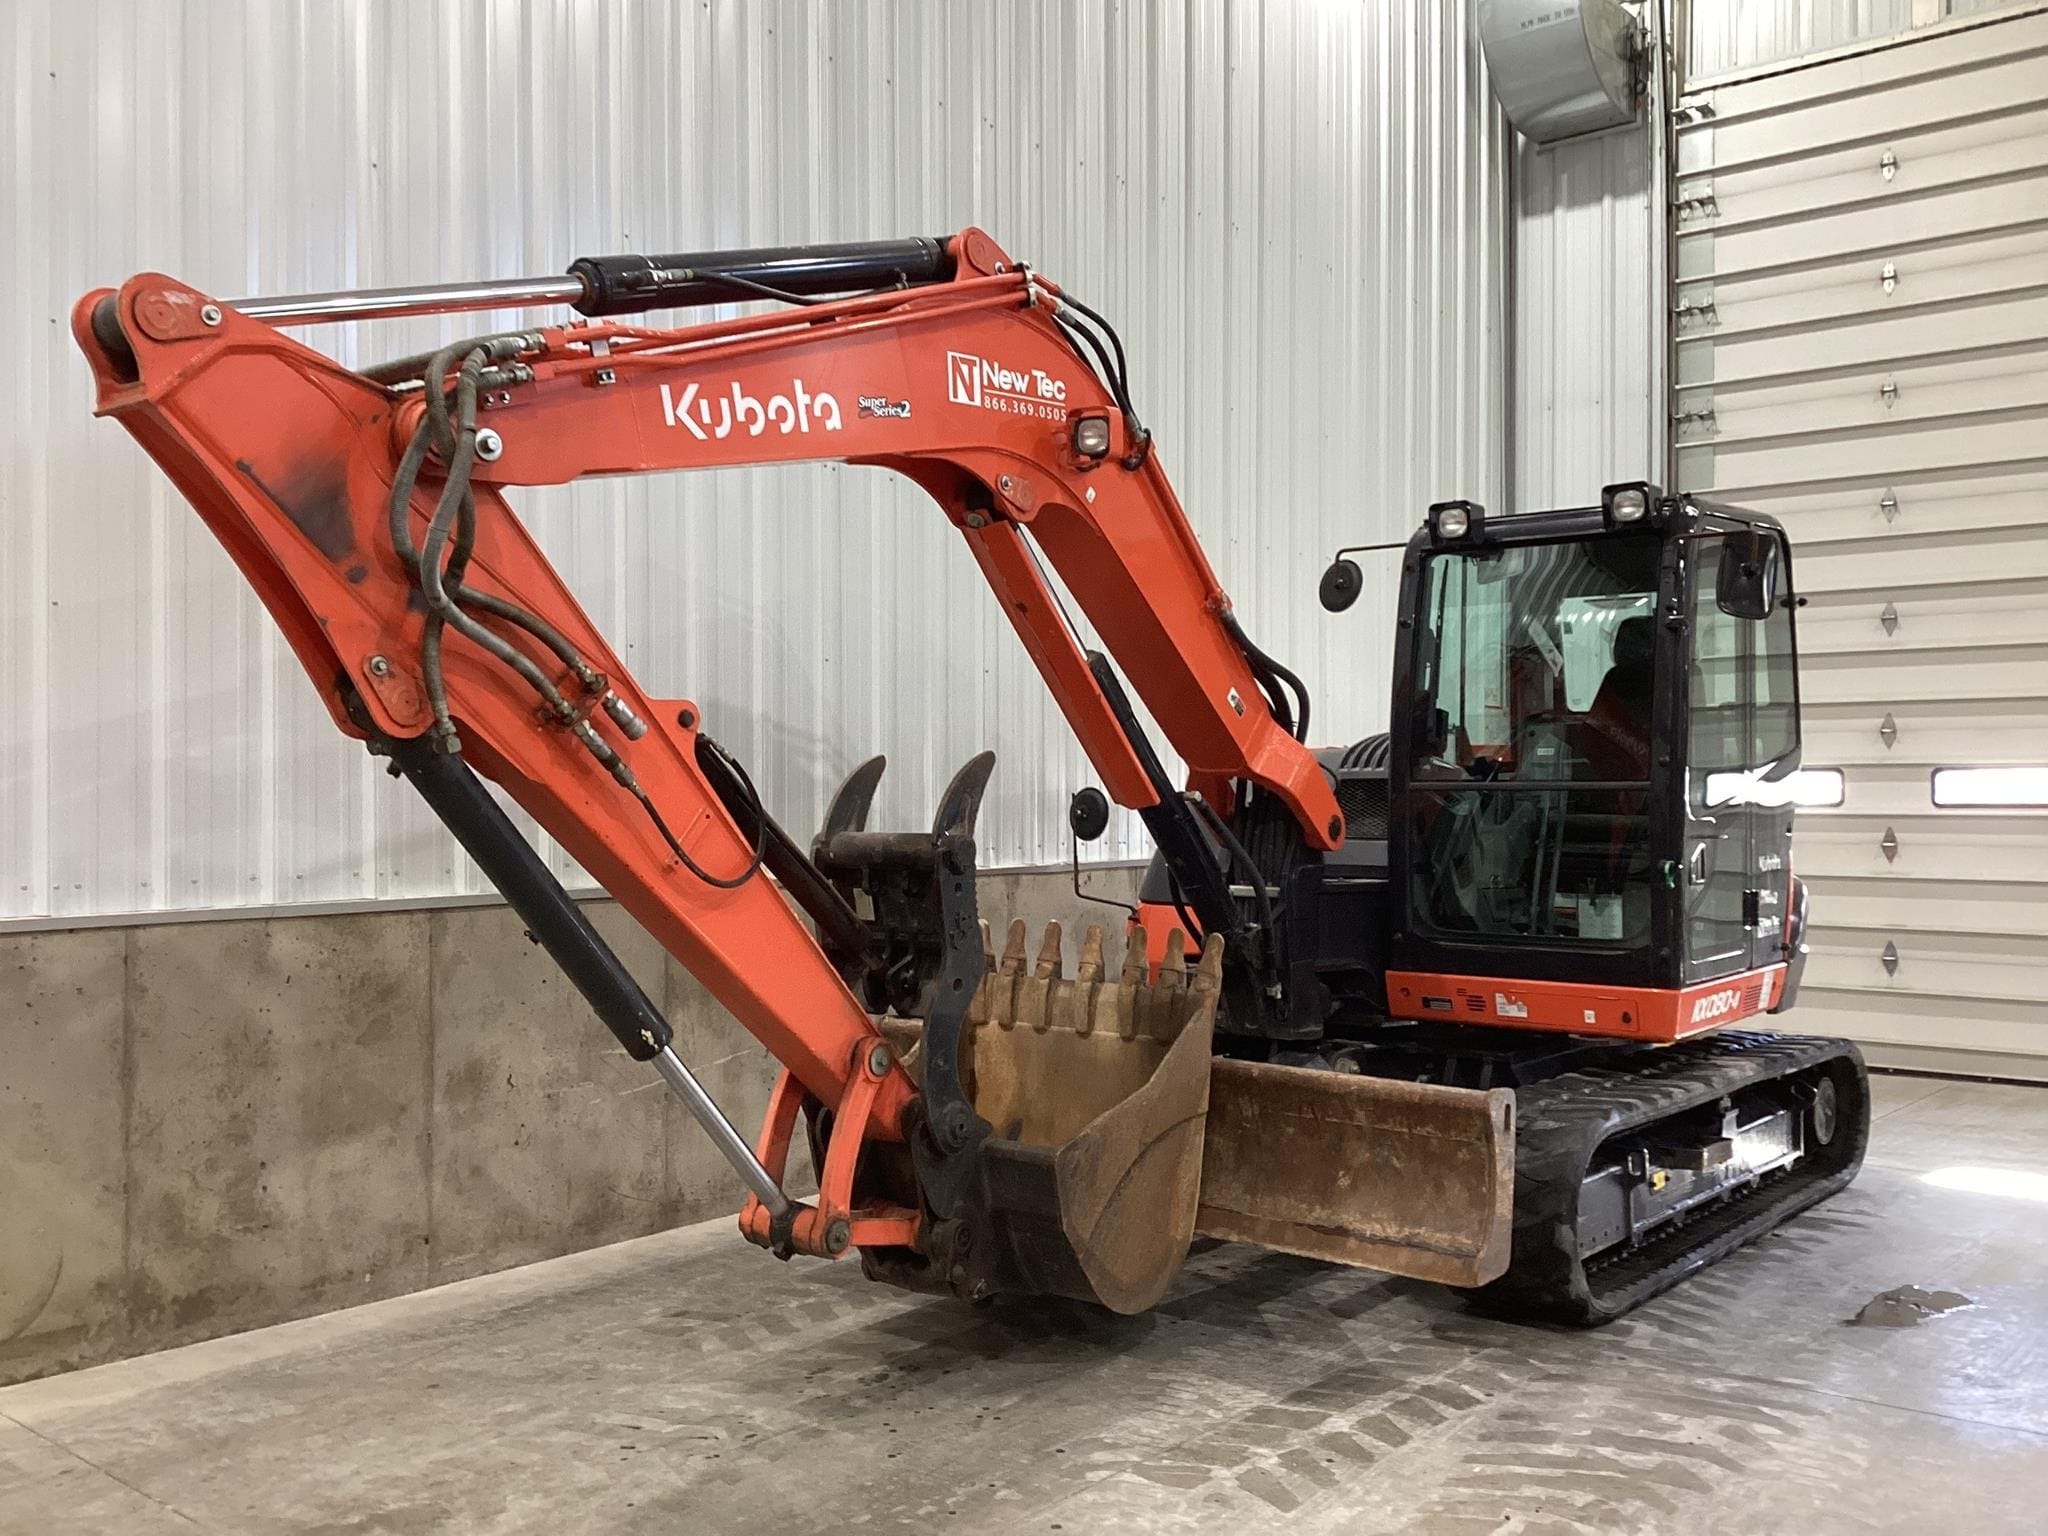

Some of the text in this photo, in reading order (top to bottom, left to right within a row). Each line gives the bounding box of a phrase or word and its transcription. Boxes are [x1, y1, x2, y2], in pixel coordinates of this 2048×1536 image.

[982, 359, 1066, 401] New Tec
[659, 378, 842, 440] Kubota
[858, 396, 886, 409] Super
[983, 396, 1067, 422] 866.369.0505
